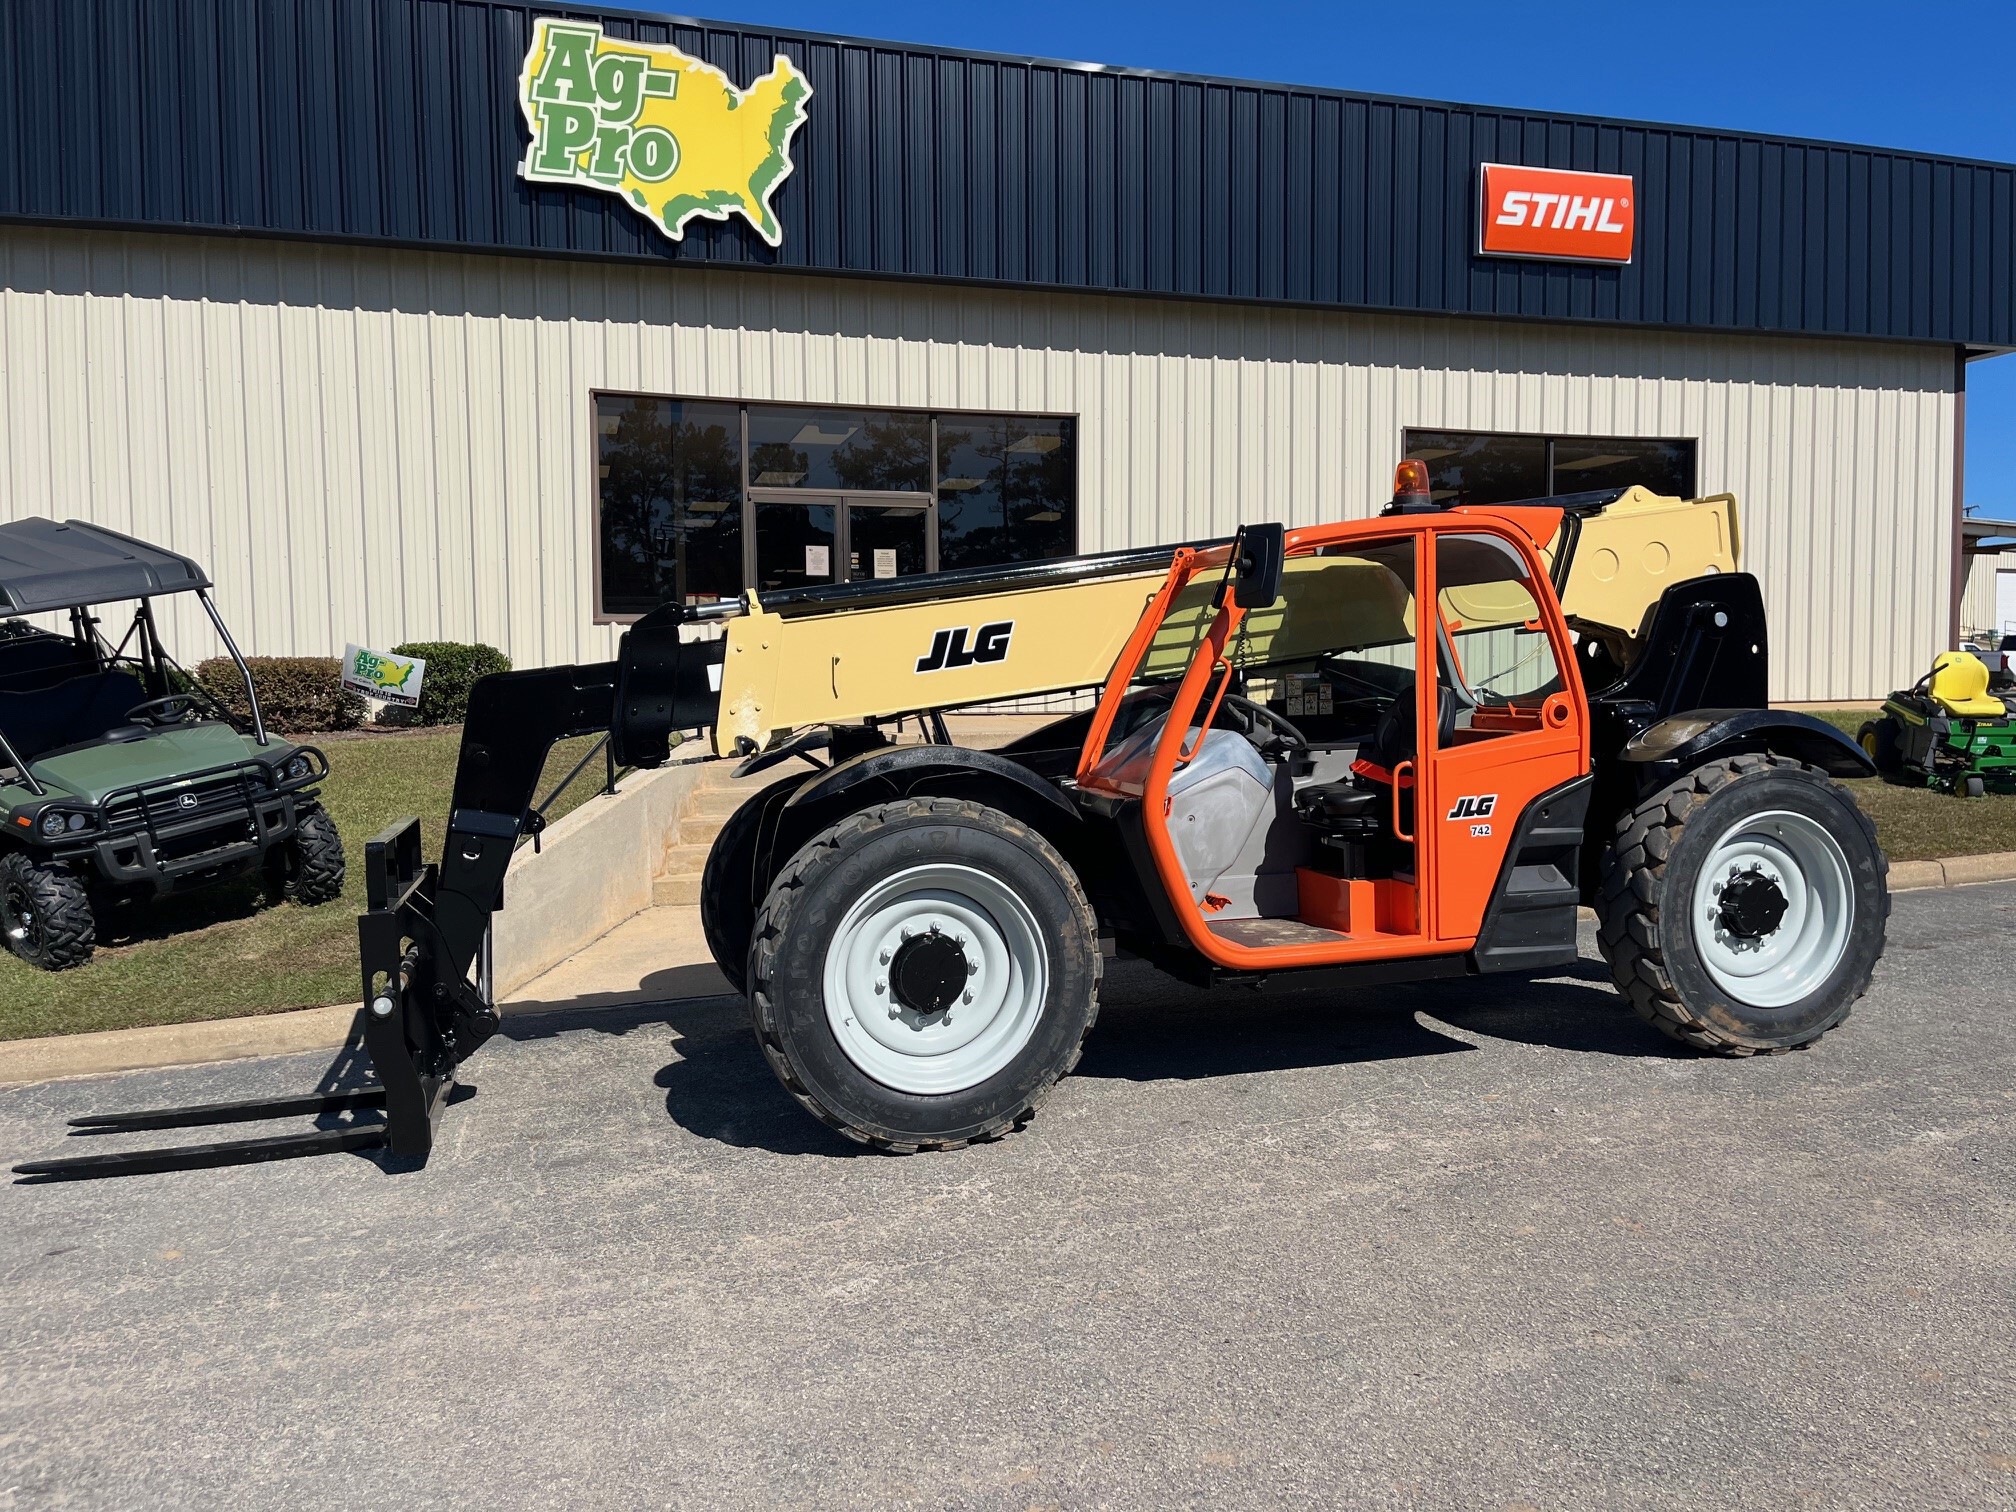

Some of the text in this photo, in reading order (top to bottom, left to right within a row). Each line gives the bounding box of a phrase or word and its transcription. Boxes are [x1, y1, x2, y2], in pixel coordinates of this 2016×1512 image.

[533, 29, 676, 121] Ag-
[535, 102, 678, 180] Pro
[1496, 191, 1623, 233] STIHL
[355, 651, 386, 668] Ag-
[916, 621, 1014, 673] JLG
[355, 663, 385, 679] Pro
[1447, 795, 1496, 819] JLG
[1471, 826, 1490, 836] 742
